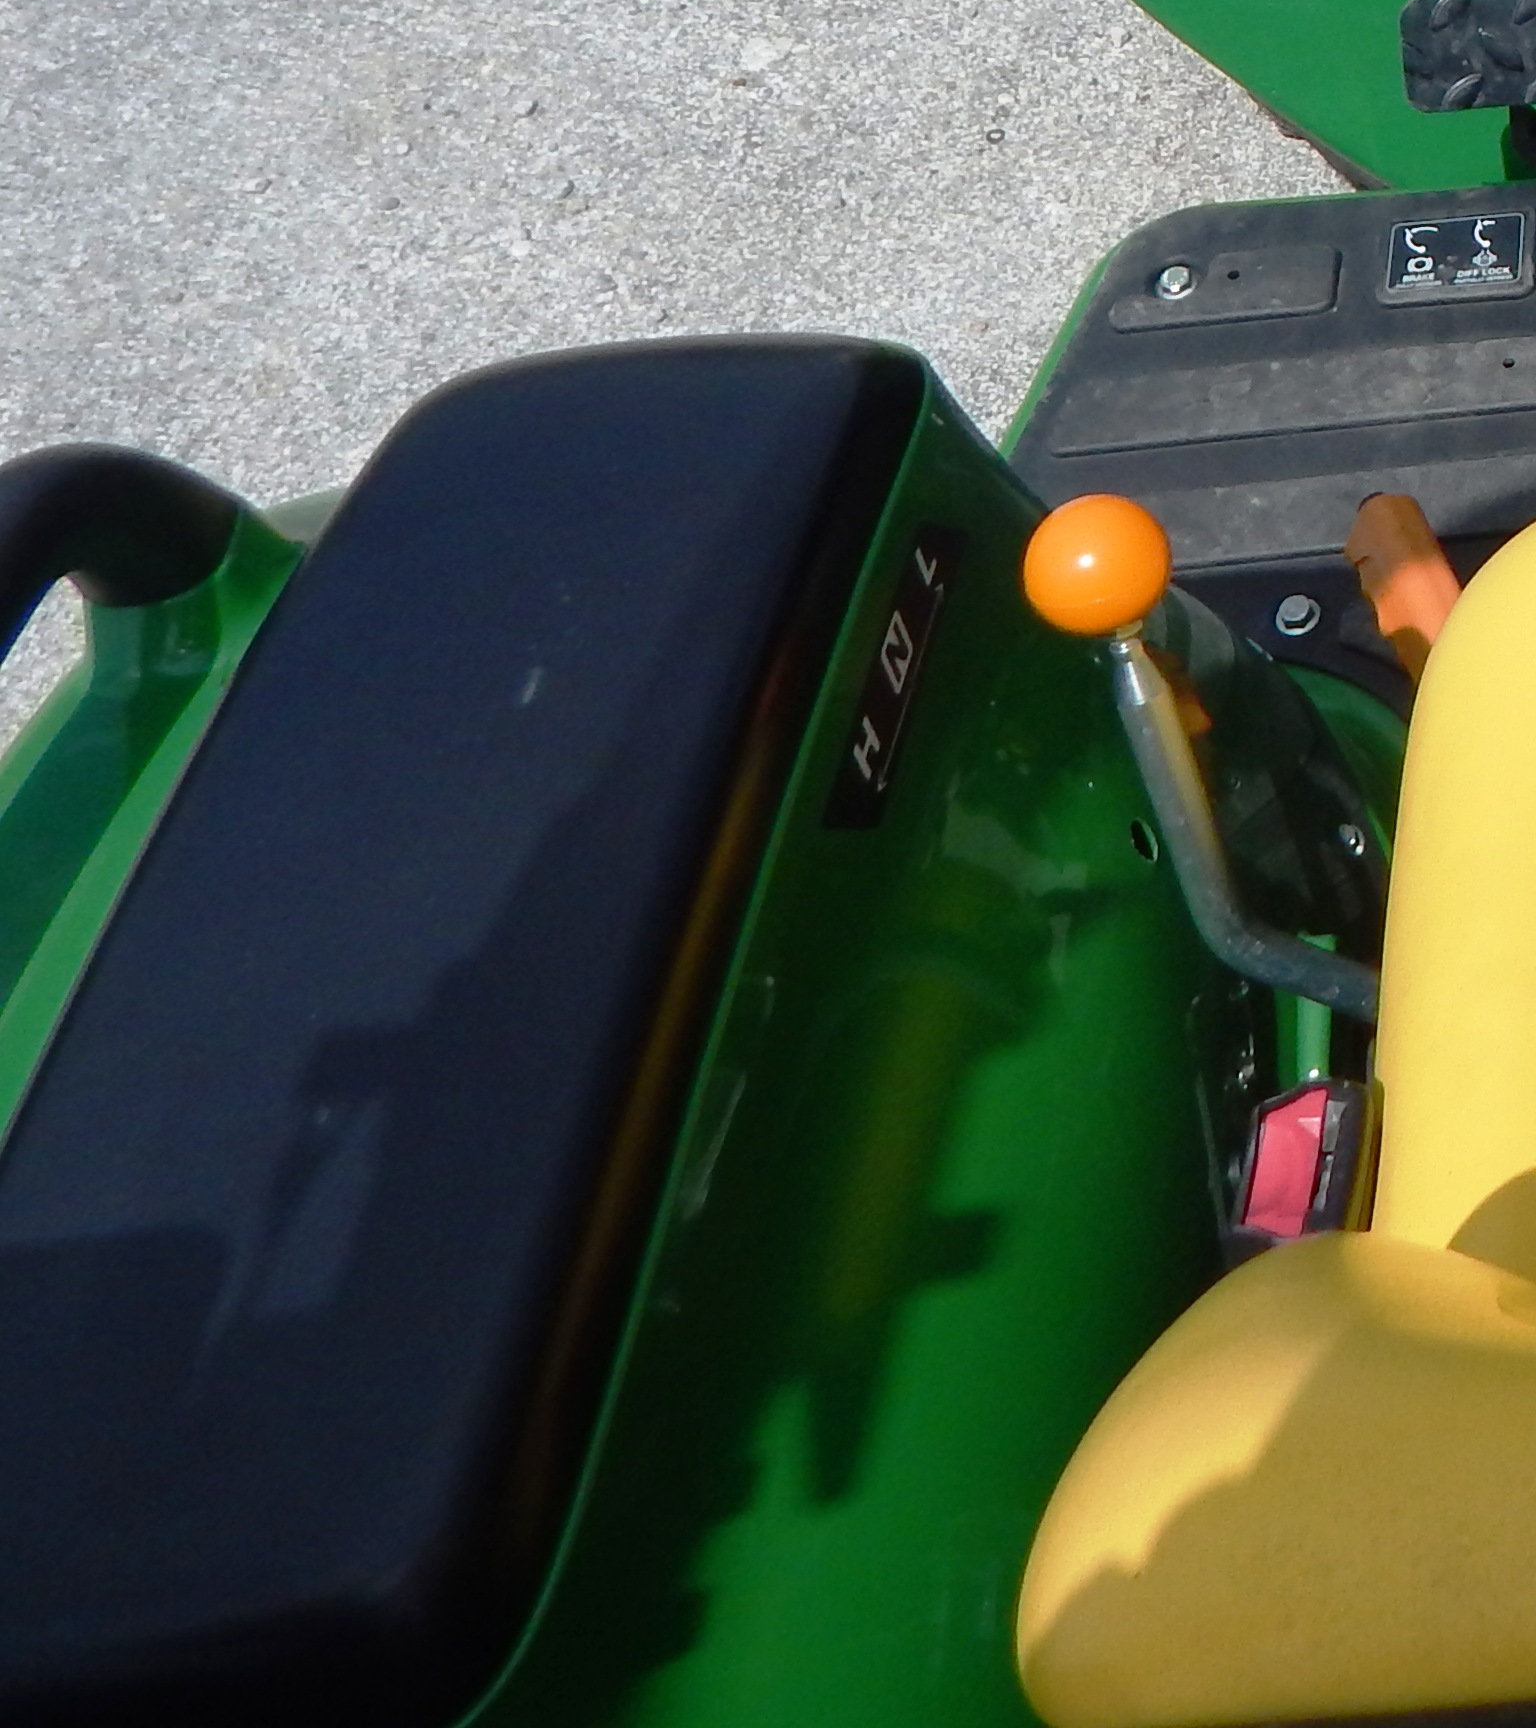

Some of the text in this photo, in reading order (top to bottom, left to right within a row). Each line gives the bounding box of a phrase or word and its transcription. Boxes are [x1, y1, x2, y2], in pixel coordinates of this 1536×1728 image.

[1402, 273, 1436, 283] BRAKE
[1456, 266, 1511, 279] DIFF LOCK
